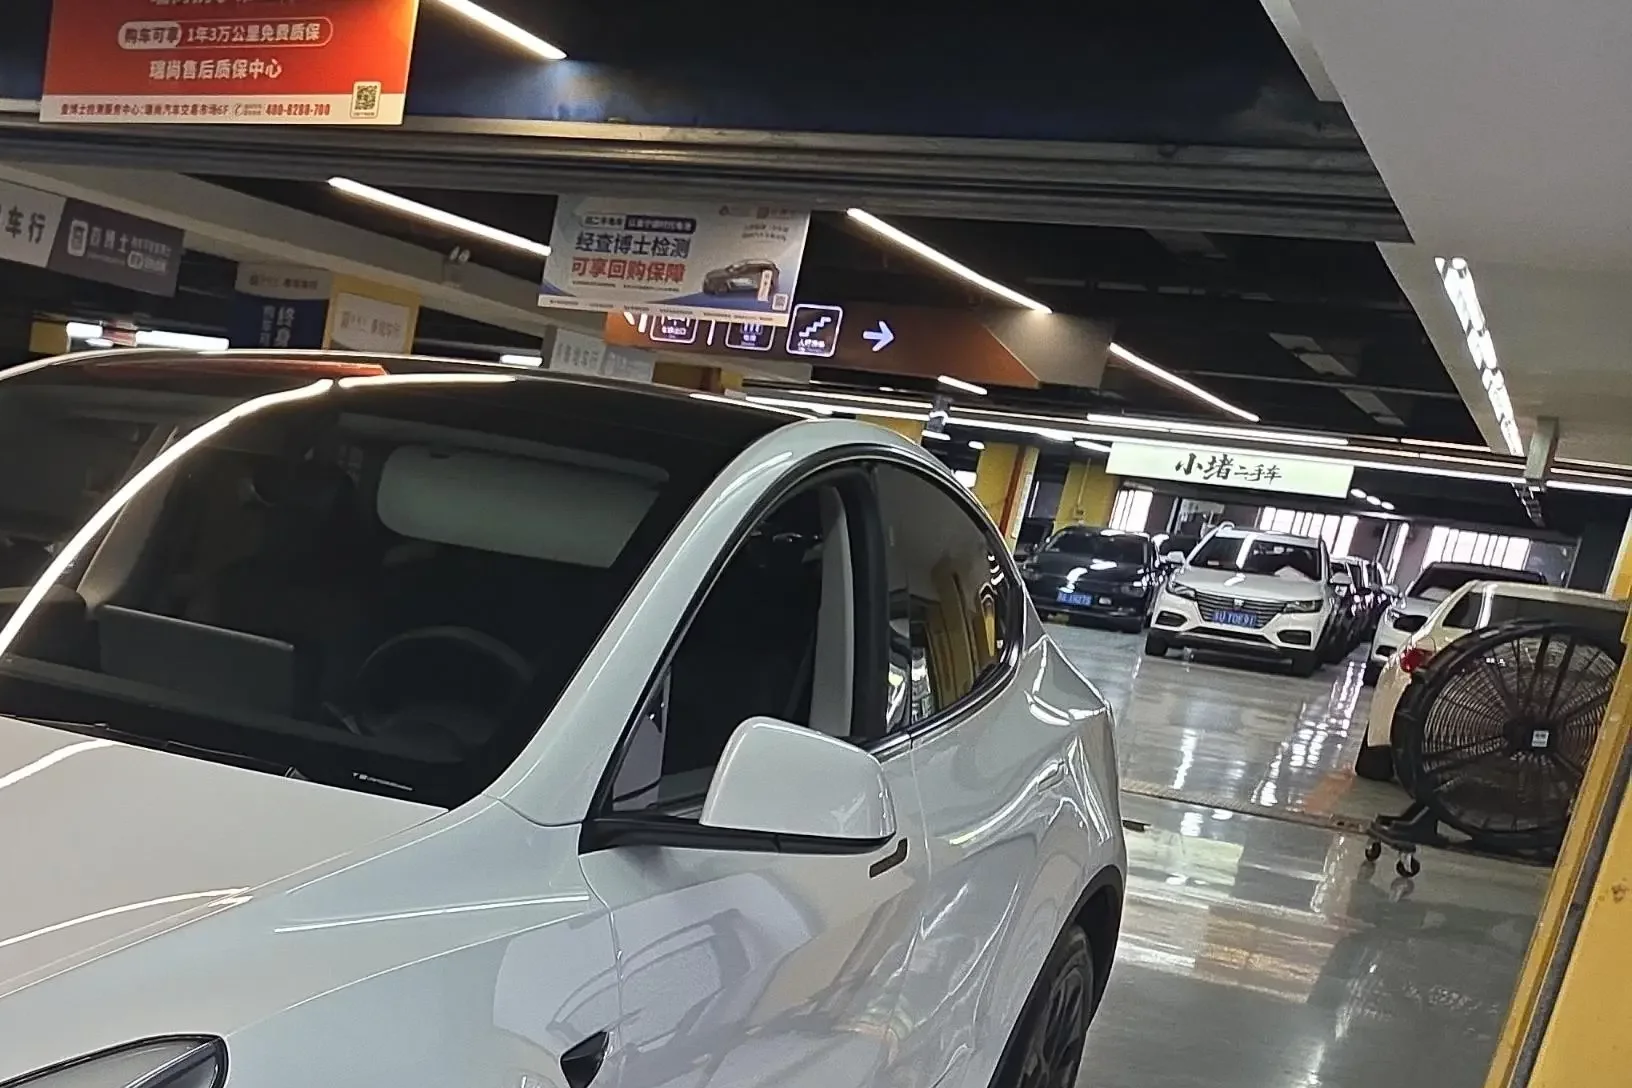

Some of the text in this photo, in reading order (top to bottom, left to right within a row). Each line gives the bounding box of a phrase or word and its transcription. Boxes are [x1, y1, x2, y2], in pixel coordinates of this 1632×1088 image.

[575, 231, 691, 259] 经查博士检测
[571, 256, 686, 284] 可享回购保障
